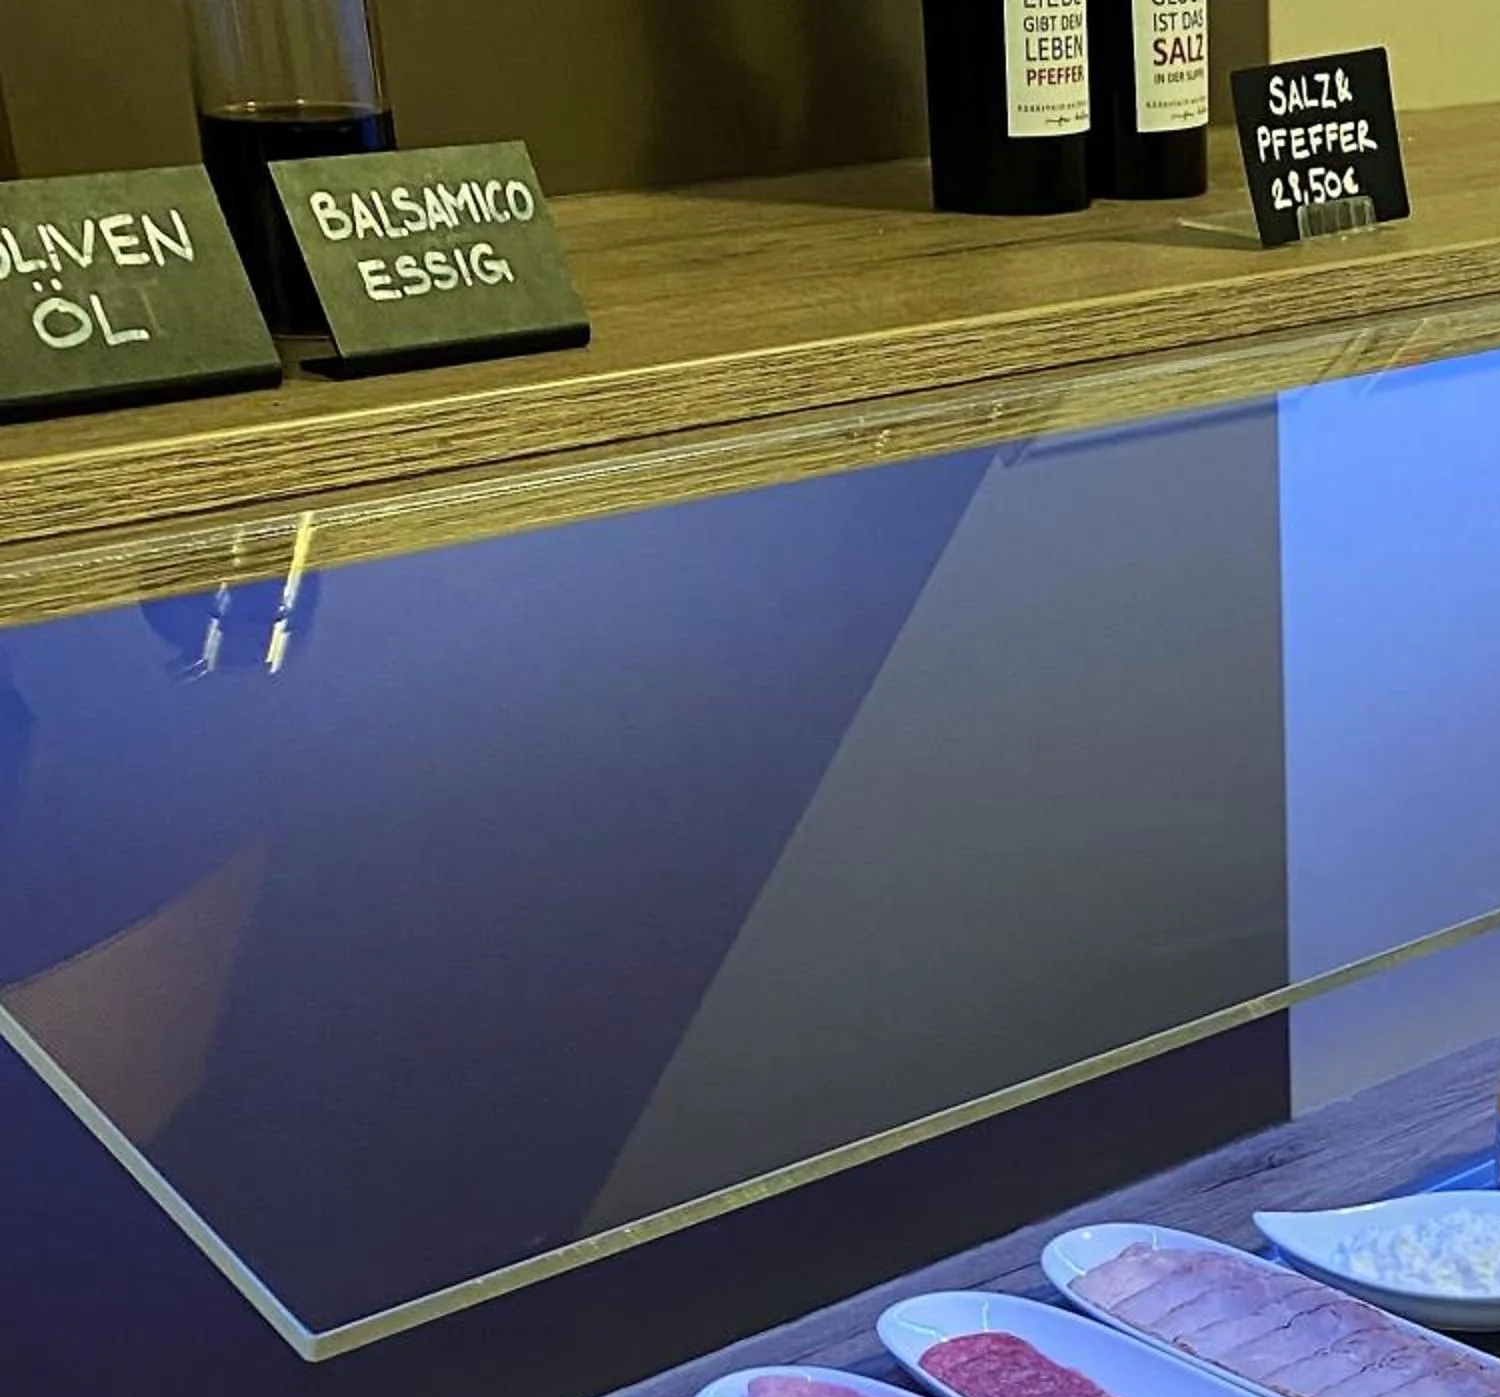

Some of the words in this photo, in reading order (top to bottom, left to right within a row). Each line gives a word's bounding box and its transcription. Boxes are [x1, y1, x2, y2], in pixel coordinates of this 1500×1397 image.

[1023, 15, 1057, 33] GIBT
[1153, 12, 1178, 32] IST
[1025, 34, 1083, 62] LEBEN
[1153, 33, 1204, 66] SALZ
[1026, 64, 1084, 87] PFEFFER
[1256, 119, 1378, 163] PFEFFER
[309, 179, 535, 241] BALSAMICO
[0, 209, 194, 280] LIVEN
[357, 242, 515, 301] ESSIG
[32, 278, 150, 349] ÖL
